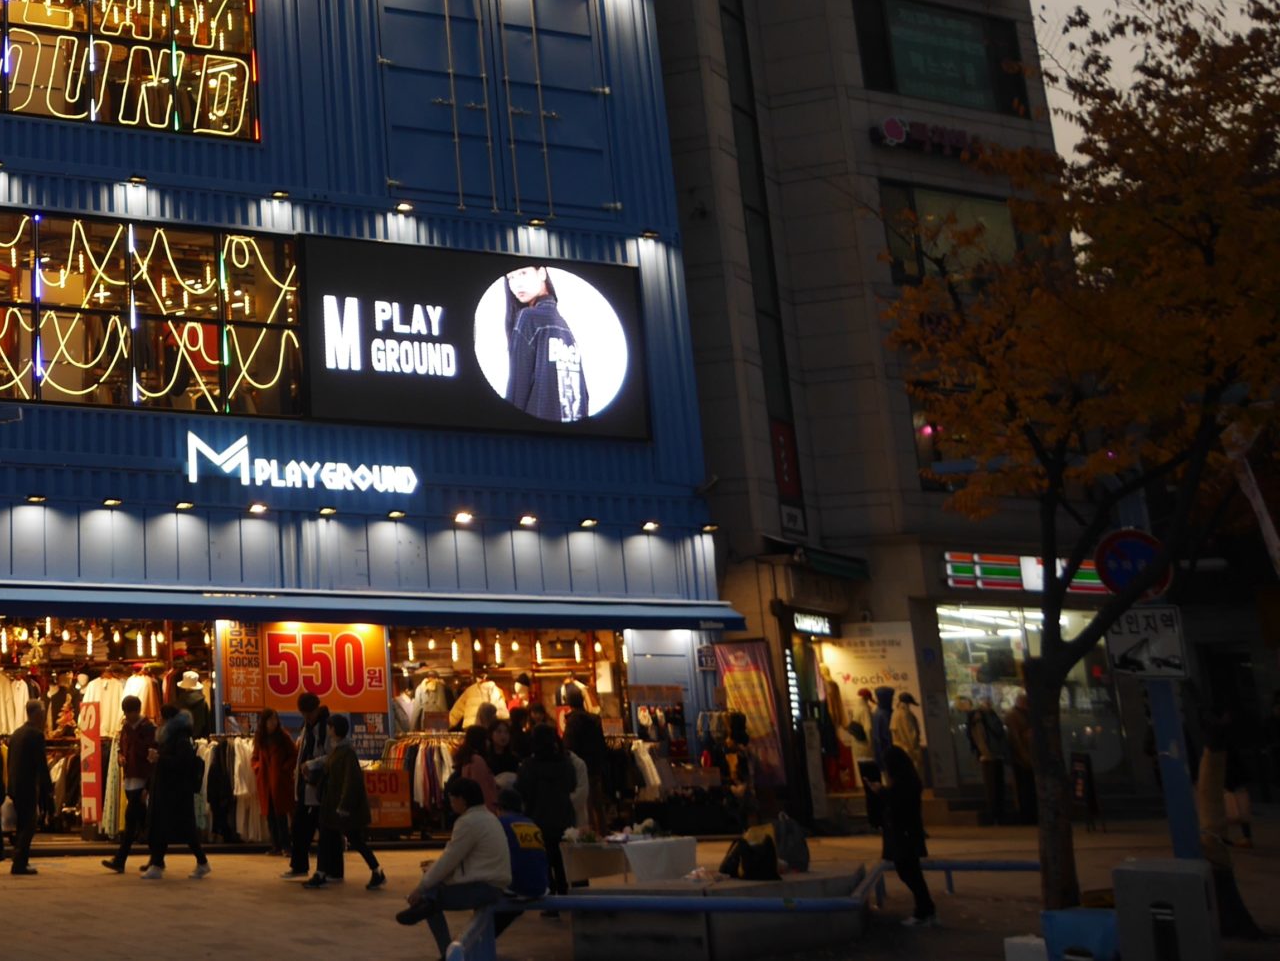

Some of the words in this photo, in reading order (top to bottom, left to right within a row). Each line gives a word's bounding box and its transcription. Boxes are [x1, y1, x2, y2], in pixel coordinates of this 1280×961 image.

[323, 294, 362, 371] M
[375, 300, 443, 337] PLAY
[371, 337, 457, 377] GROUND
[255, 457, 419, 495] PLAYGROUND
[228, 638, 259, 655] 덧신
[228, 656, 260, 668] SOCKS
[266, 631, 366, 698] 550
[367, 667, 385, 691] 원
[80, 704, 97, 821] SALE
